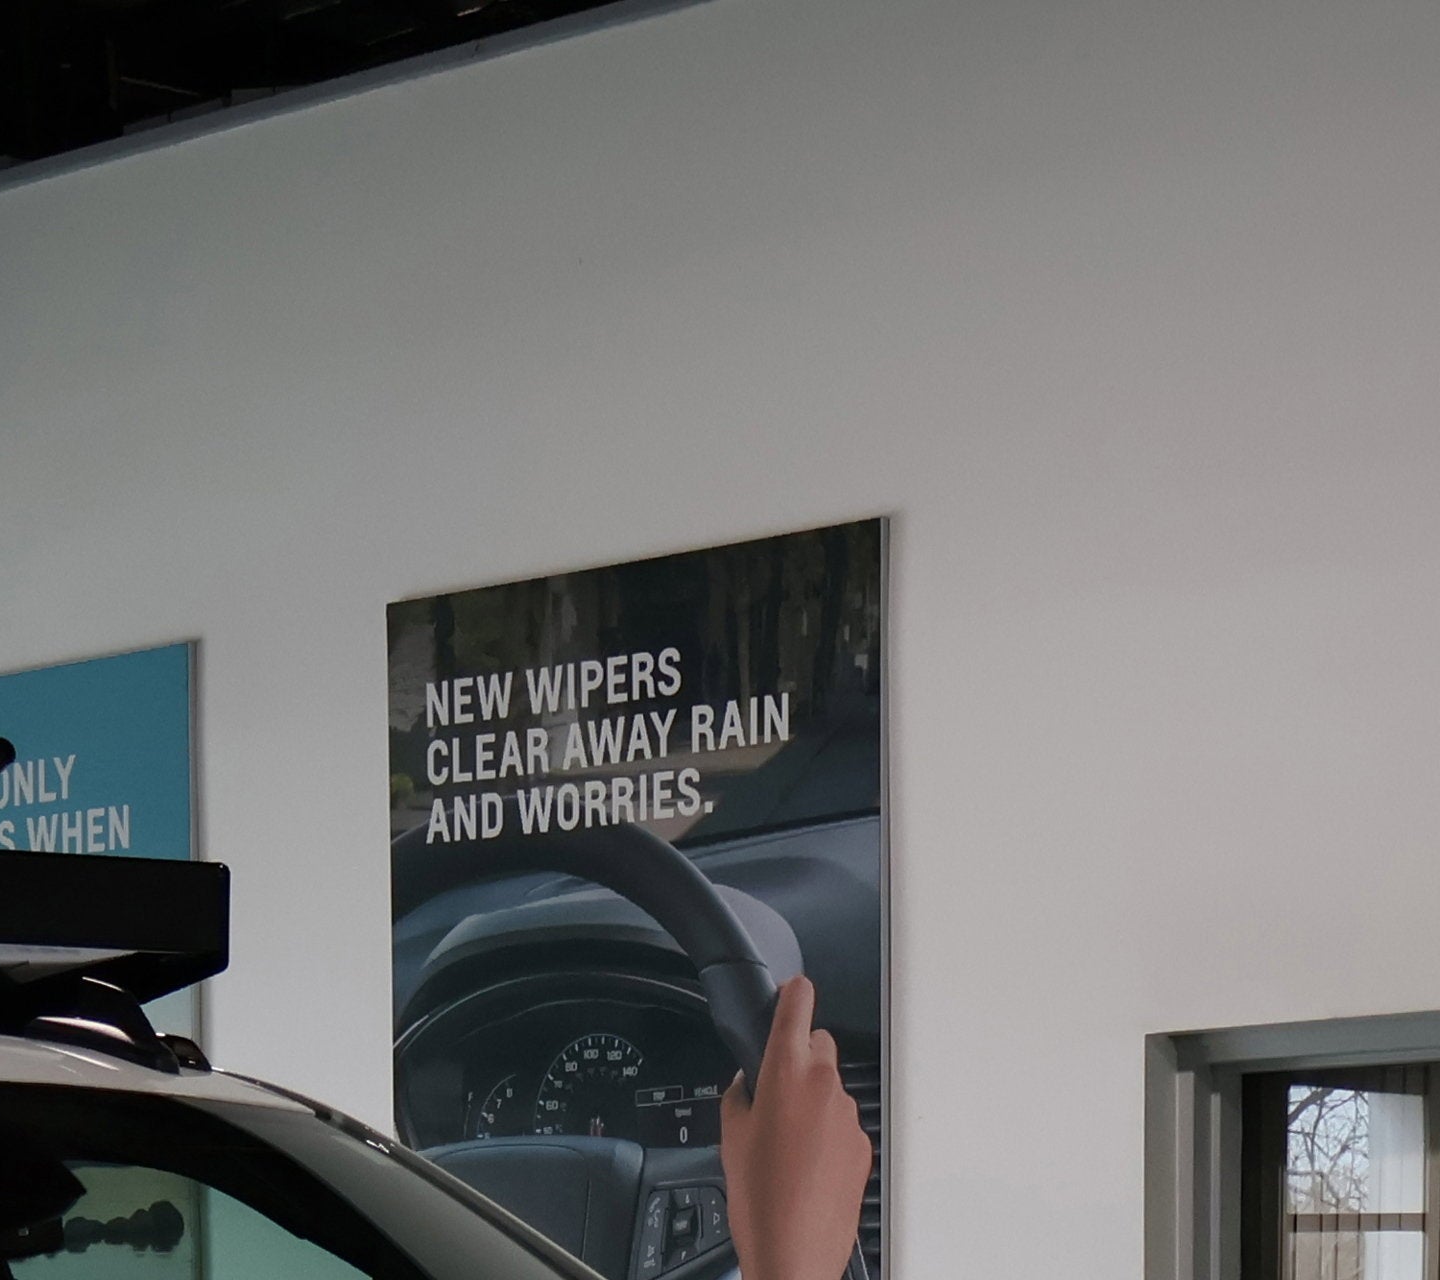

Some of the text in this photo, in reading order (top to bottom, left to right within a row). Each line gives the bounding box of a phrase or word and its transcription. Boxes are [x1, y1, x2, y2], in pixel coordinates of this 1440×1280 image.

[425, 647, 682, 728] NEW WIPERS
[426, 691, 791, 786] CLEAR AWAY RAIN
[26, 804, 131, 855] WHEN
[425, 767, 715, 845] AND WORRIES.
